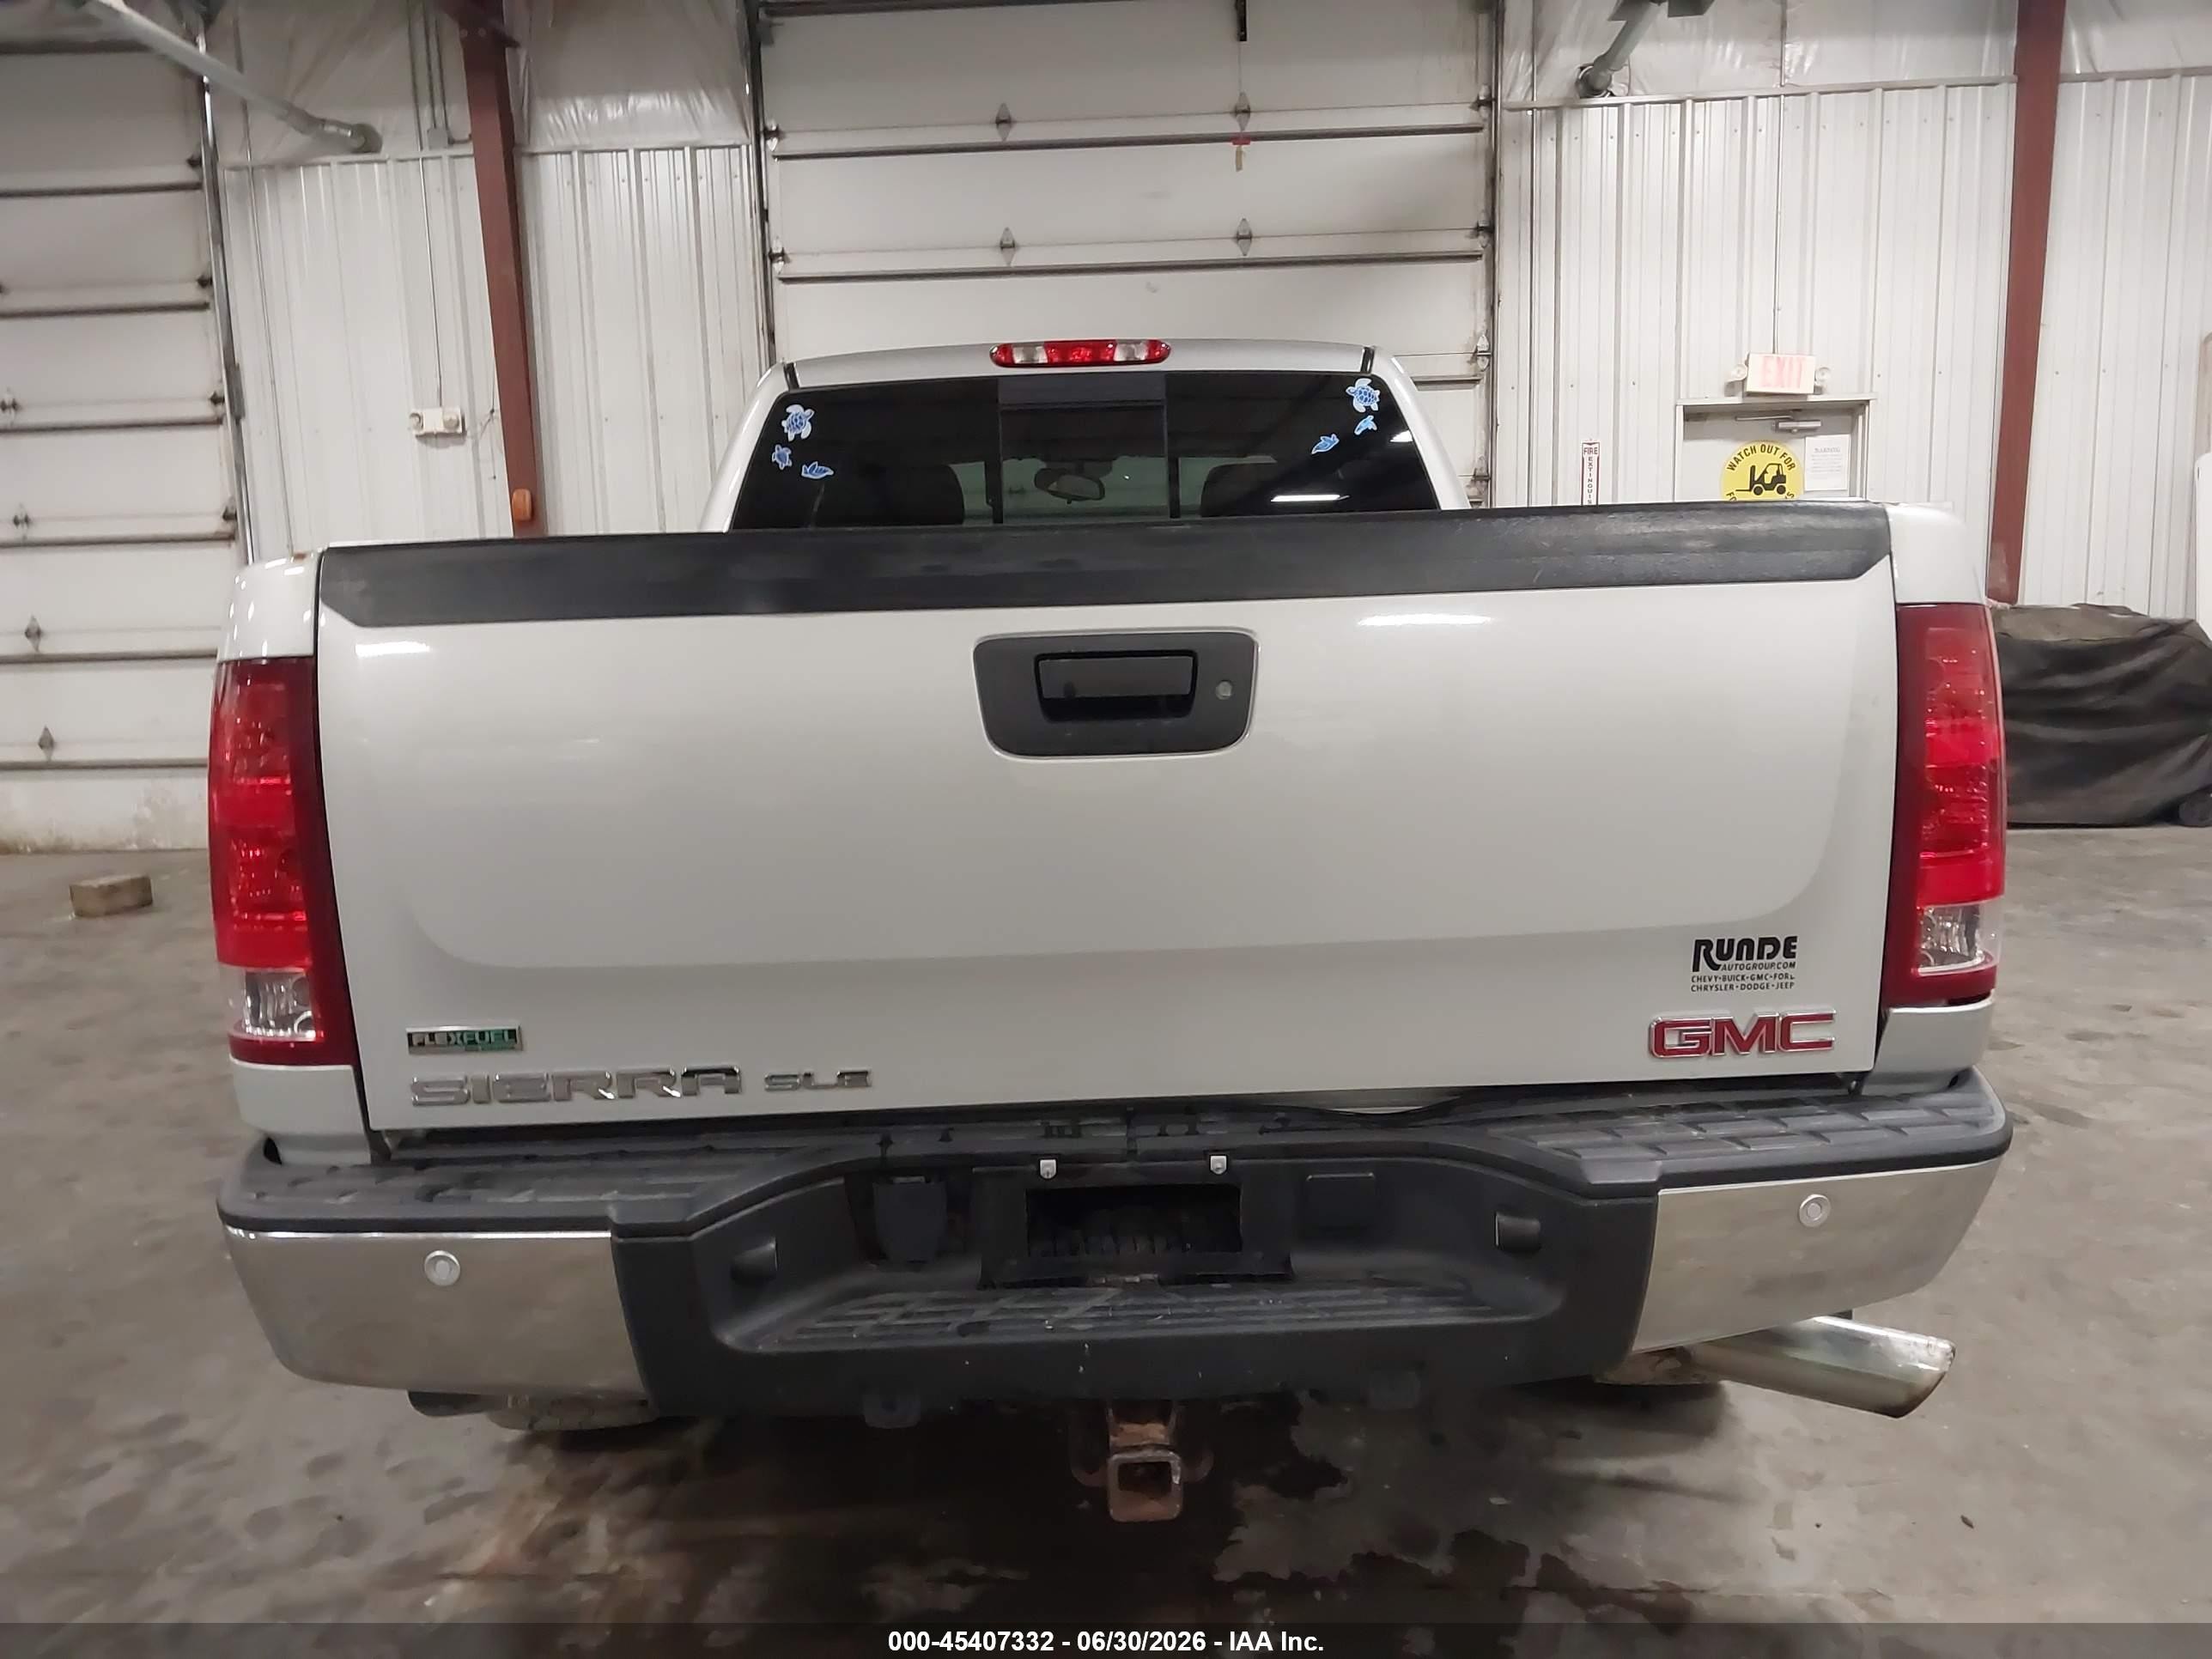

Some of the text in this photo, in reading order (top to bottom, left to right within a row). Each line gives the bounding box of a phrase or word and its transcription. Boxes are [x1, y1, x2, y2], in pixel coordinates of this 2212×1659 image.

[1759, 355, 1806, 389] EXIT
[1583, 447, 1598, 455] FIRE
[1726, 445, 1757, 471] WATCH
[1760, 443, 1781, 456] OUT
[1778, 452, 1796, 471] FOR
[1721, 961, 1796, 972] AUTOGROUP.COM
[1691, 975, 1719, 983] CHEVY
[1691, 983, 1735, 993] CHRYSLER
[1740, 981, 1771, 991] DODGE
[1649, 1008, 1836, 1058] GMC
[410, 1066, 871, 1107] SIERRA SLE
